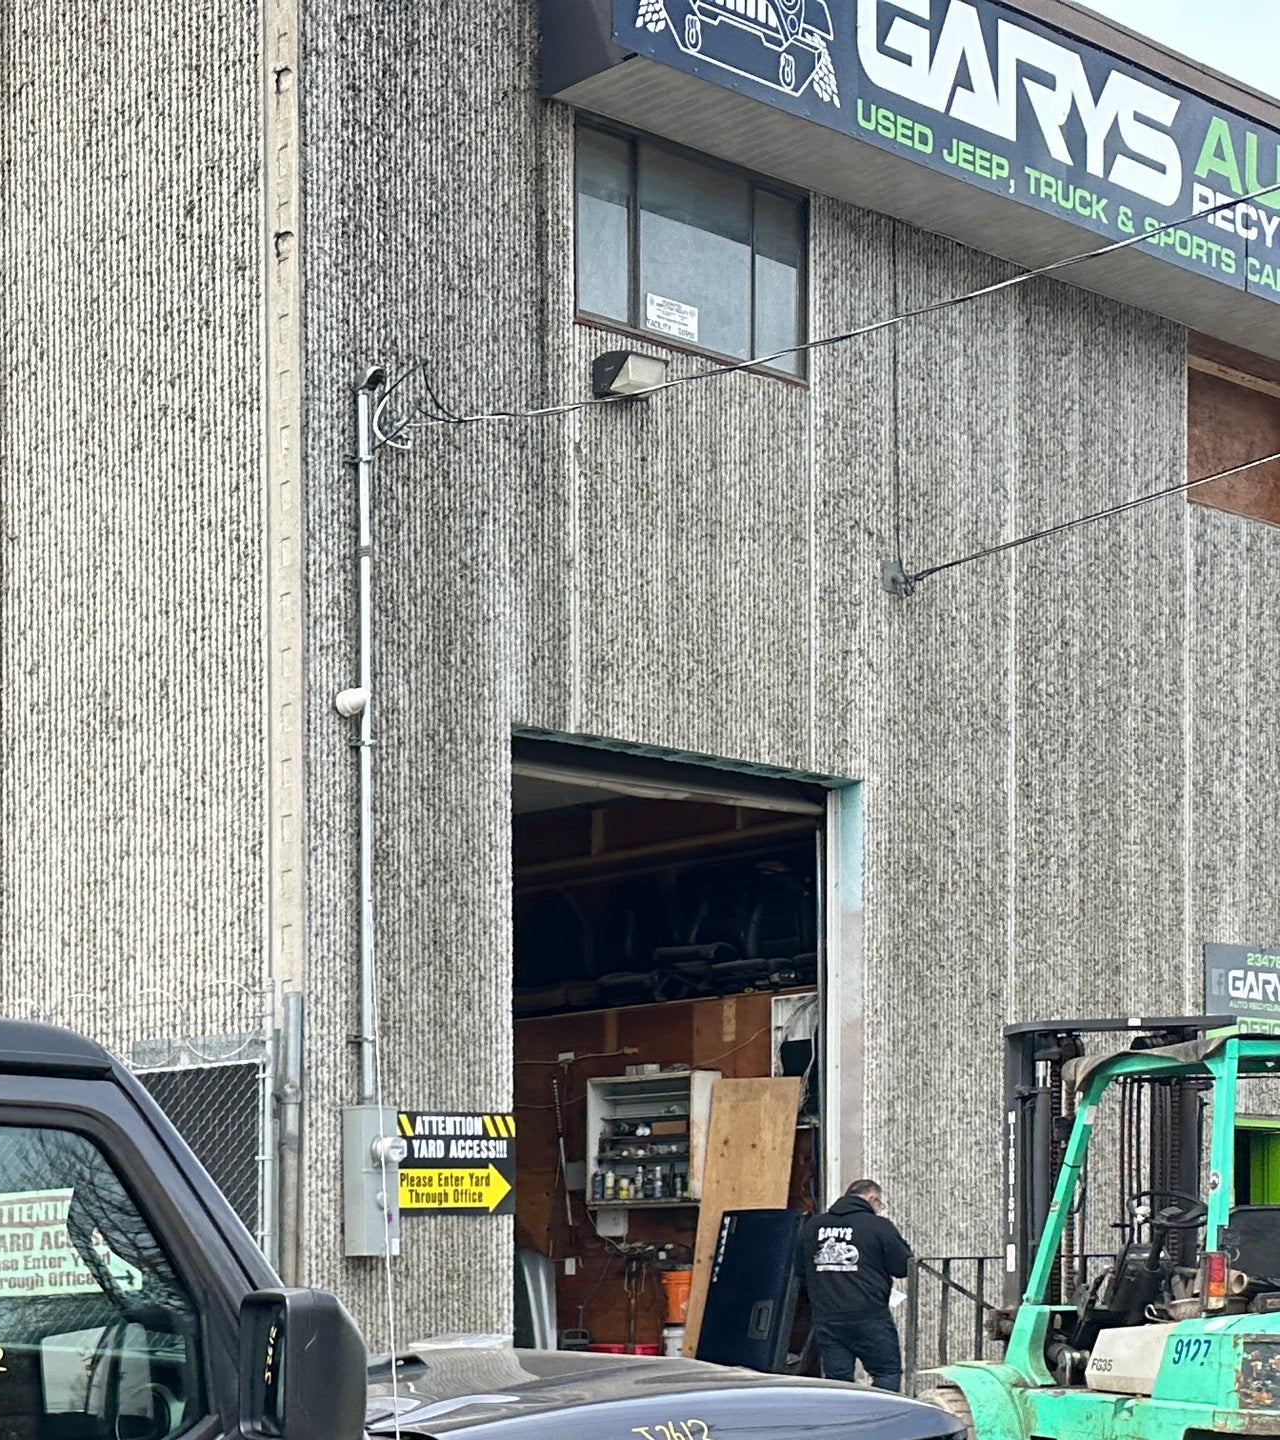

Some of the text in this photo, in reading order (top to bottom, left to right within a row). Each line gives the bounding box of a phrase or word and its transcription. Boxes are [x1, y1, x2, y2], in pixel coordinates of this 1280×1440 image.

[857, 0, 1185, 209] GARYS
[856, 99, 934, 155] USED
[943, 138, 1016, 194] JEEP,
[1024, 166, 1109, 225] TRUCK
[1117, 206, 1135, 235] &
[1144, 217, 1236, 275] SPORTS
[414, 1115, 484, 1136] ATTENTION
[412, 1139, 445, 1159] YARD
[449, 1139, 508, 1159] ACCESS!!!
[399, 1172, 491, 1188] Please Enter Yard
[1007, 1110, 1016, 1235] MITSUBISHI
[408, 1189, 483, 1206] Through Office
[23, 1254, 68, 1271] Enter
[48, 1271, 96, 1287] Office
[1090, 1358, 1113, 1372] FG35
